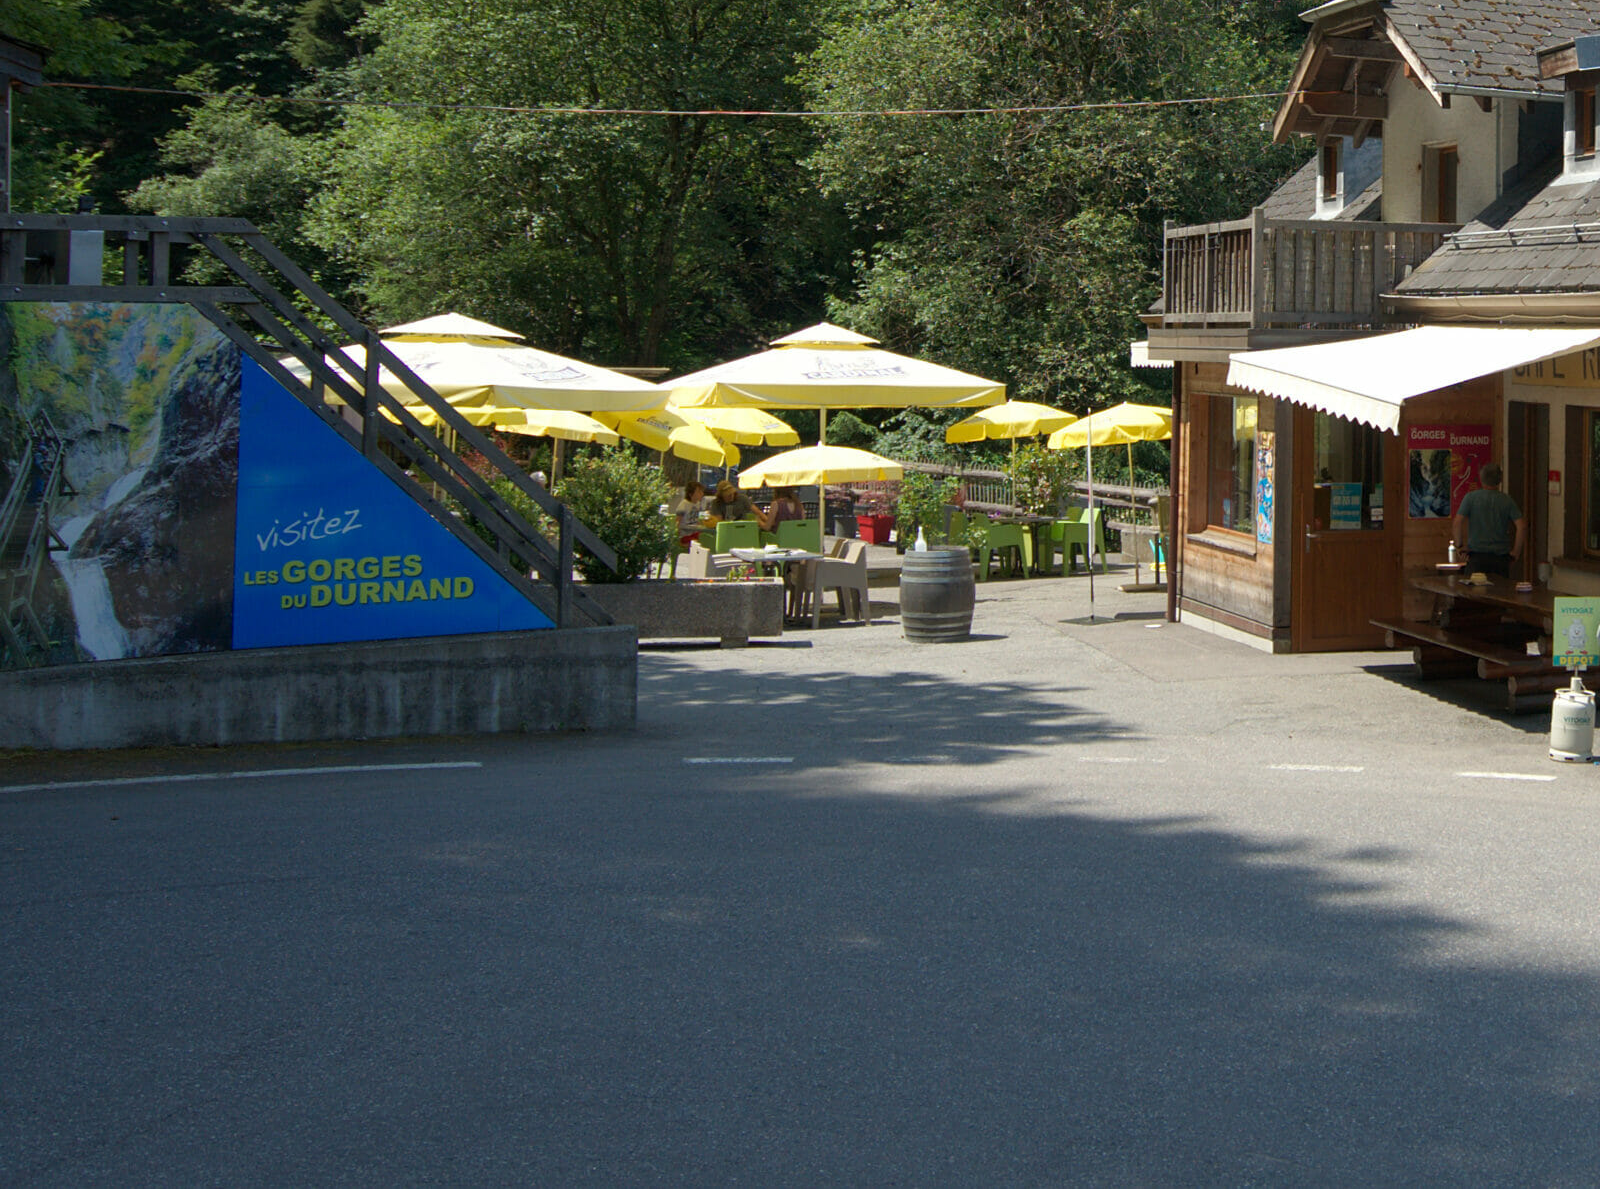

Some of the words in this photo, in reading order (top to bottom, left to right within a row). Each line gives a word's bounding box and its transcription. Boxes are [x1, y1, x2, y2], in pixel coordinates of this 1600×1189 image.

[1411, 430, 1446, 440] GORGES
[1450, 435, 1489, 445] DURNAND
[256, 508, 363, 552] visitez
[244, 570, 280, 586] LES
[282, 554, 424, 584] GORGES
[281, 594, 307, 610] DU
[310, 576, 475, 608] DURNAND
[1564, 715, 1591, 723] VITOGAZ
